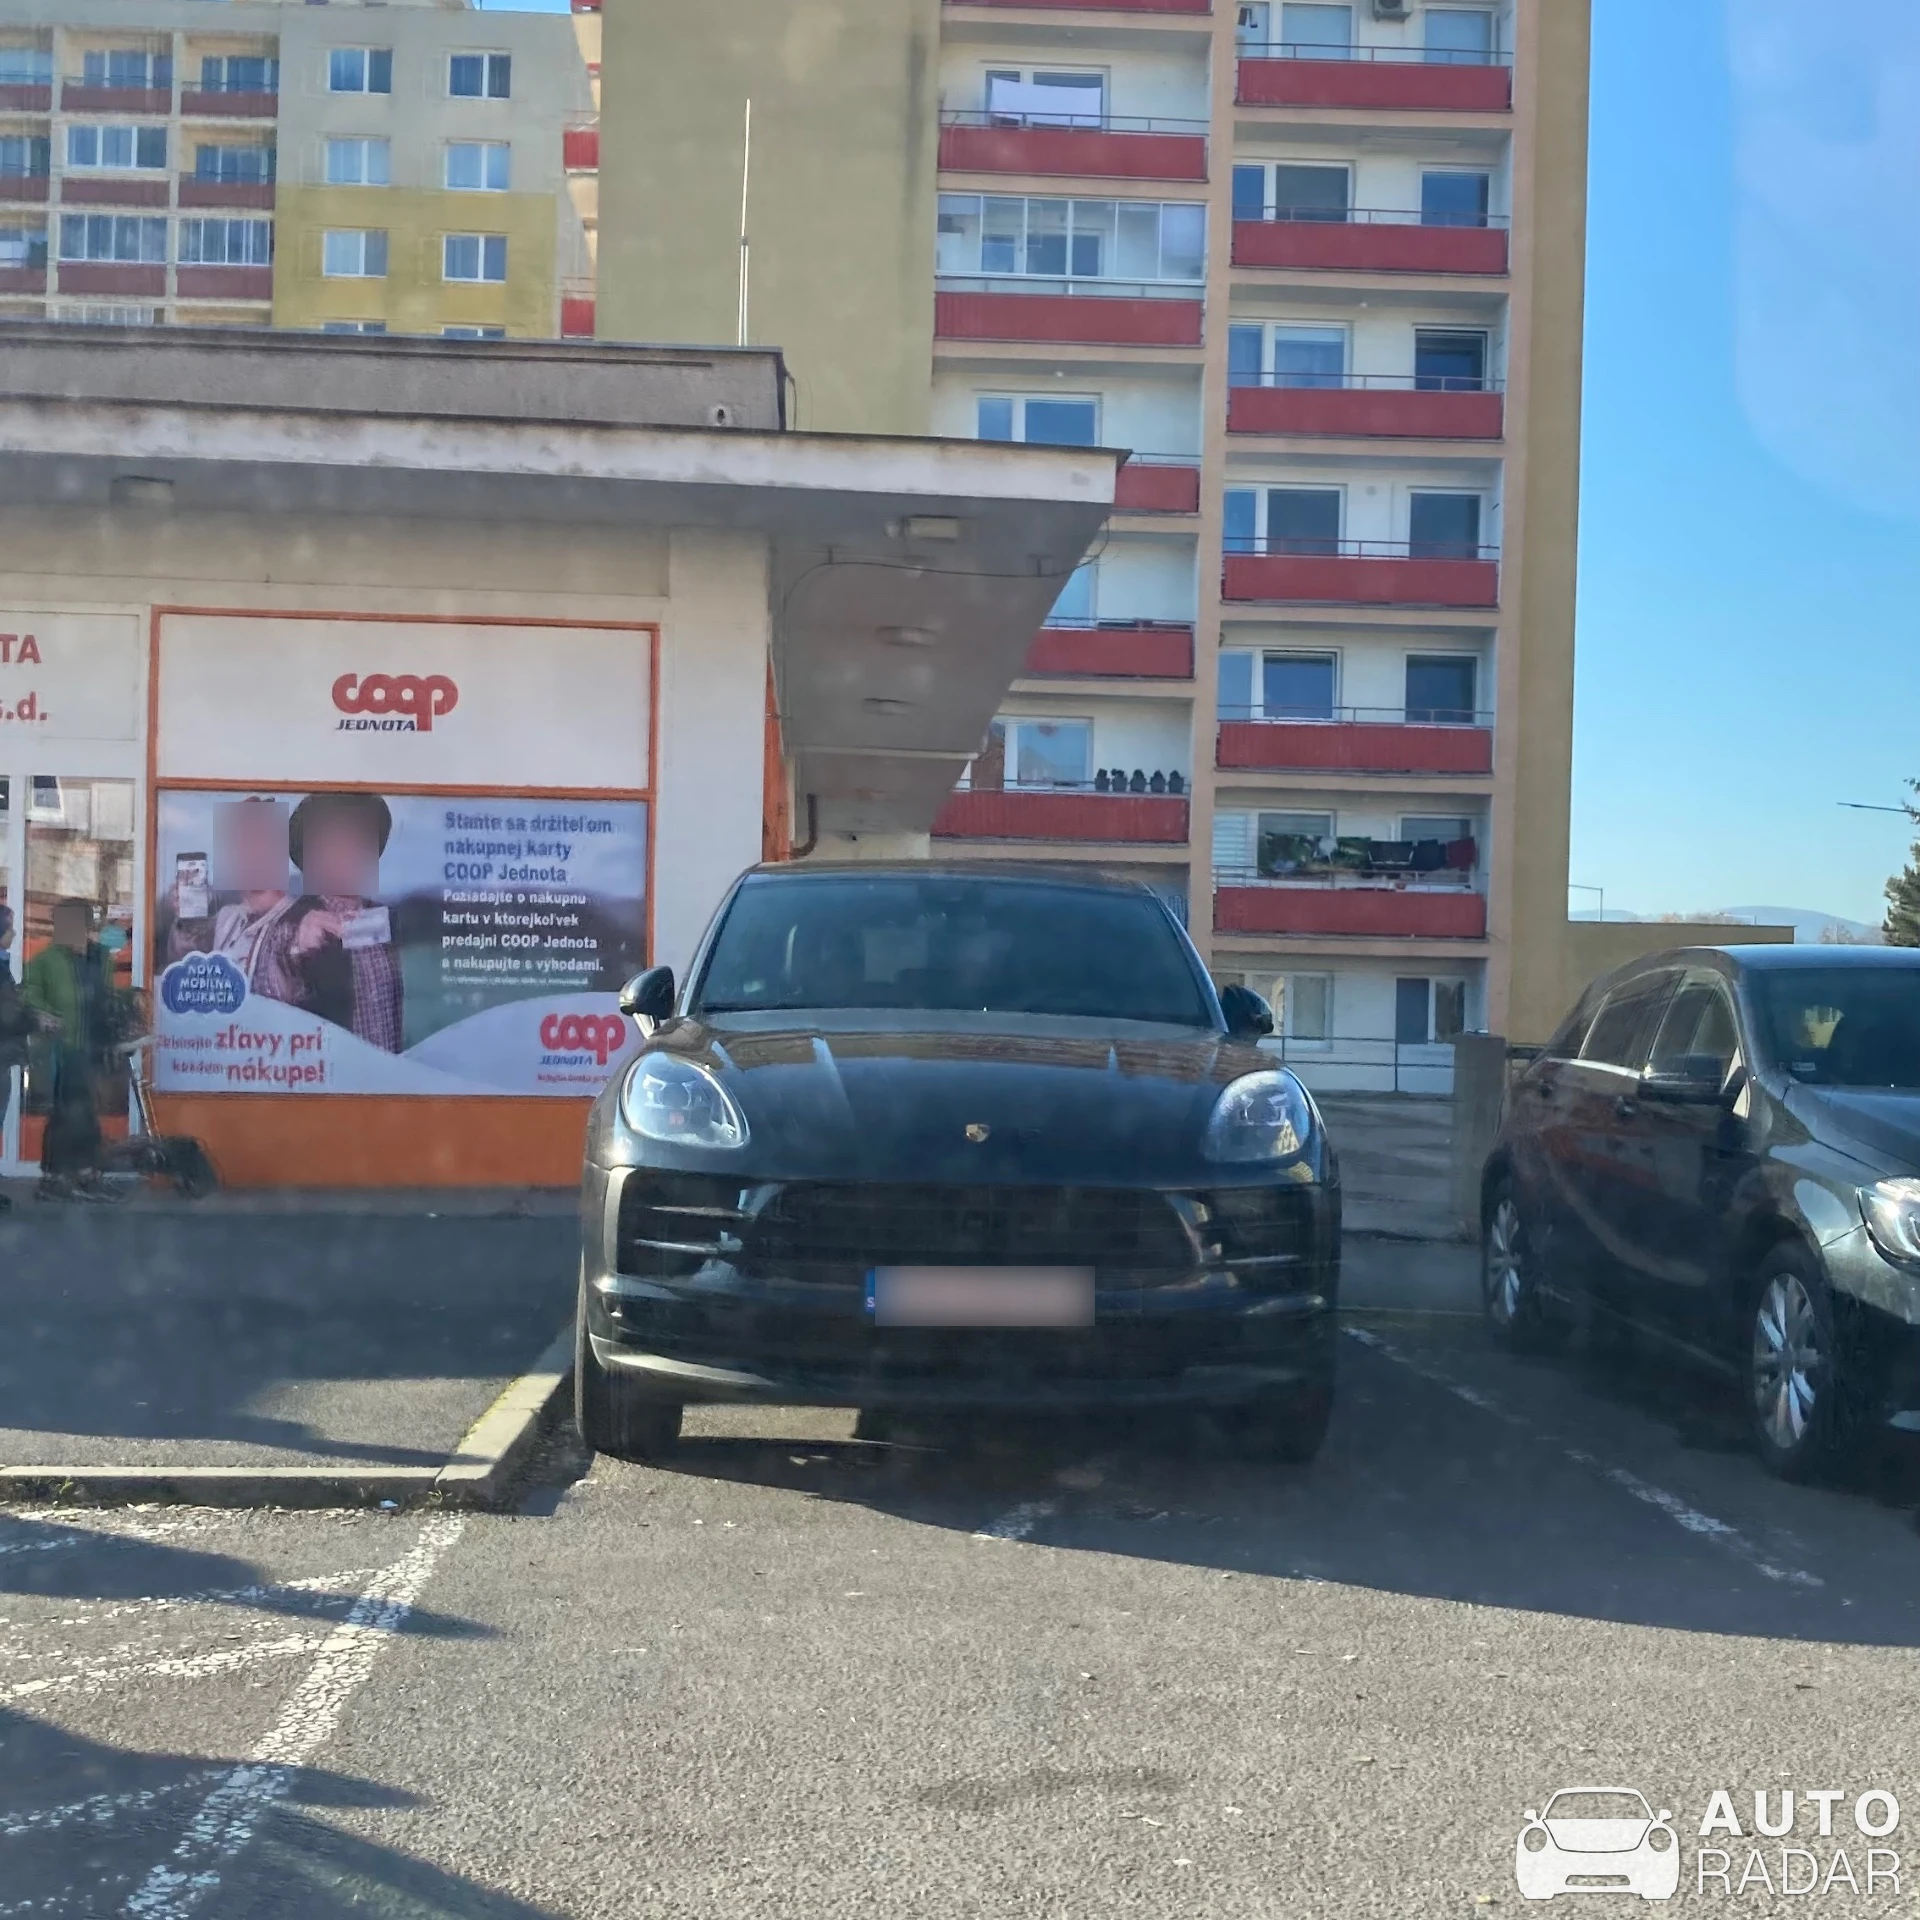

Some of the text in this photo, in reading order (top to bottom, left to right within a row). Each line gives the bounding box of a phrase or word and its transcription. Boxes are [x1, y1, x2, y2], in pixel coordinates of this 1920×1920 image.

[0, 634, 42, 664] TA
[336, 719, 417, 731] JEDNOTA
[507, 816, 526, 832] sa
[527, 840, 572, 862] karty
[444, 862, 567, 882] COOP Jednota
[517, 893, 526, 903] o
[443, 911, 479, 924] kartu
[482, 915, 490, 924] v
[442, 933, 598, 949] predajni COOP Jednota
[454, 956, 521, 972] nakupujte
[215, 1023, 283, 1056] zľavy
[290, 1026, 322, 1057] pri
[539, 1054, 594, 1066] JEDNOTA
[227, 1056, 325, 1089] nákupe!
